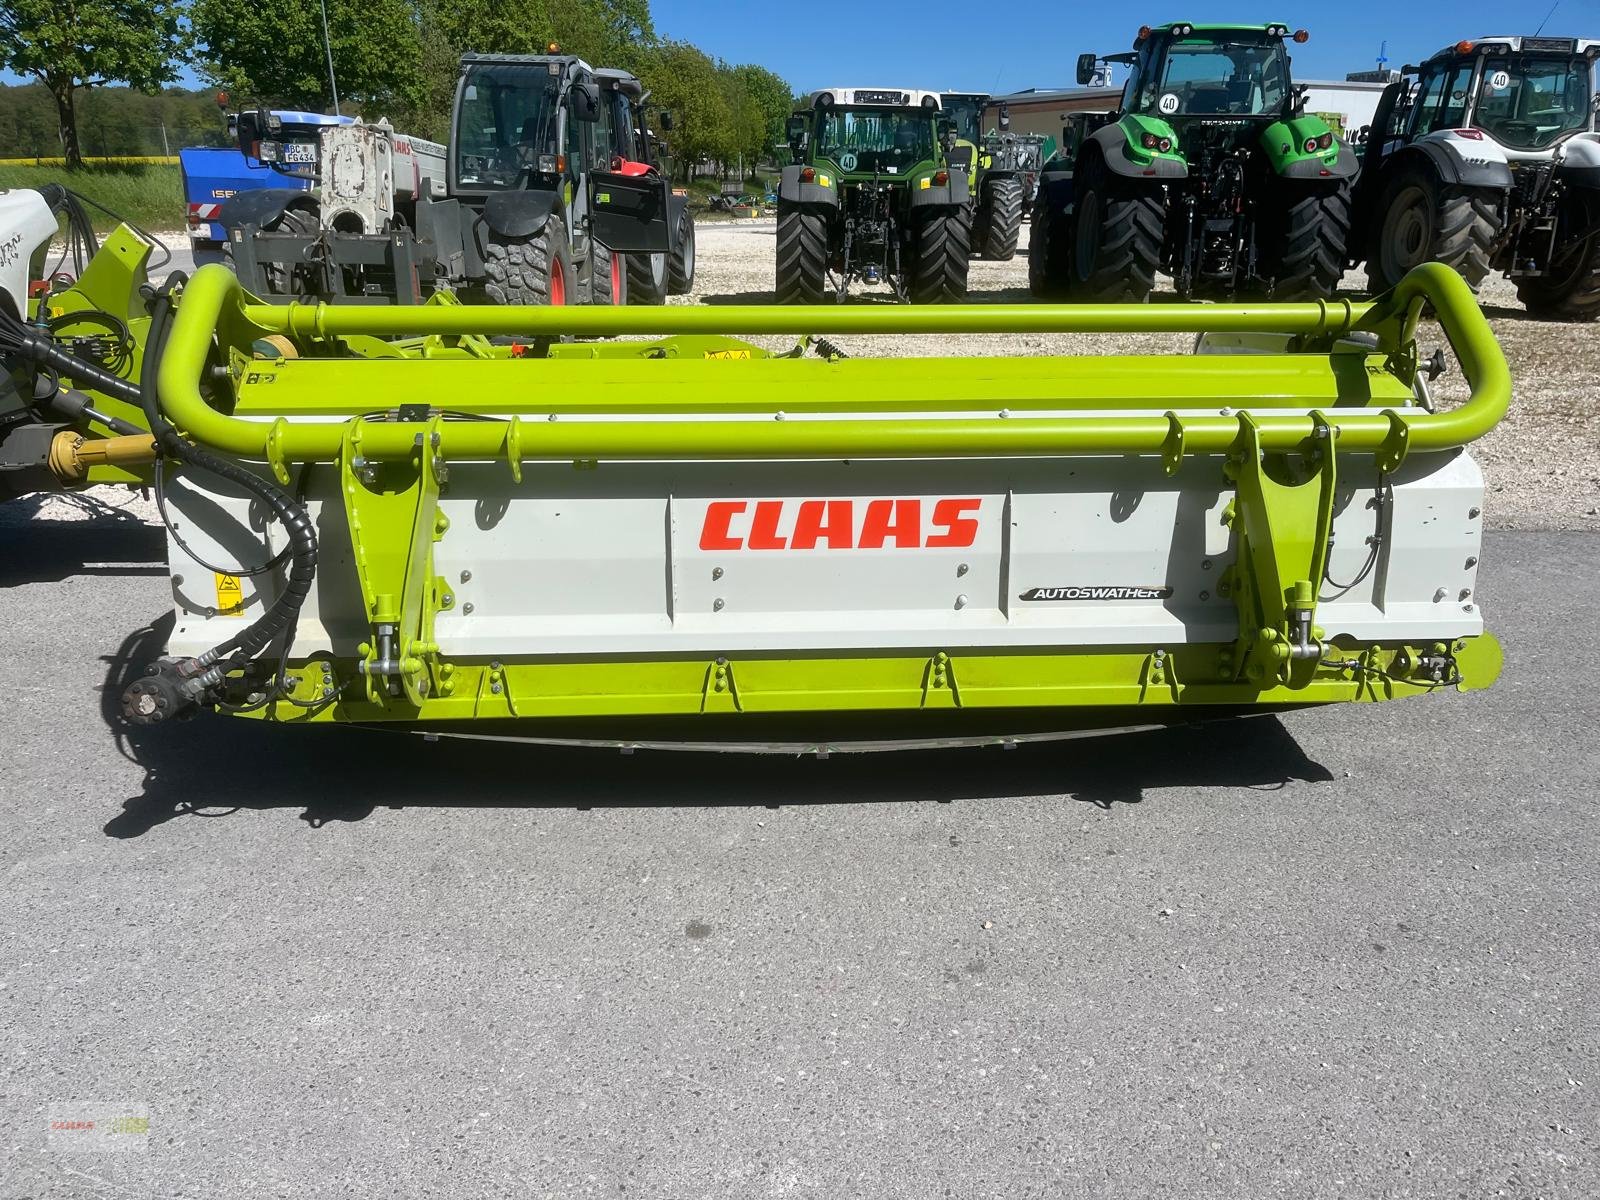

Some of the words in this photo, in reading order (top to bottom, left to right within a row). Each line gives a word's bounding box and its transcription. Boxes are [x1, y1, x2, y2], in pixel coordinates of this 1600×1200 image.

[1493, 74, 1506, 87] 40
[1163, 97, 1175, 110] 40
[290, 144, 300, 154] BC
[843, 154, 854, 167] 40
[212, 190, 237, 198] ISE
[699, 498, 982, 550] CLAAS
[1033, 588, 1160, 599] AUTOSWATHER
